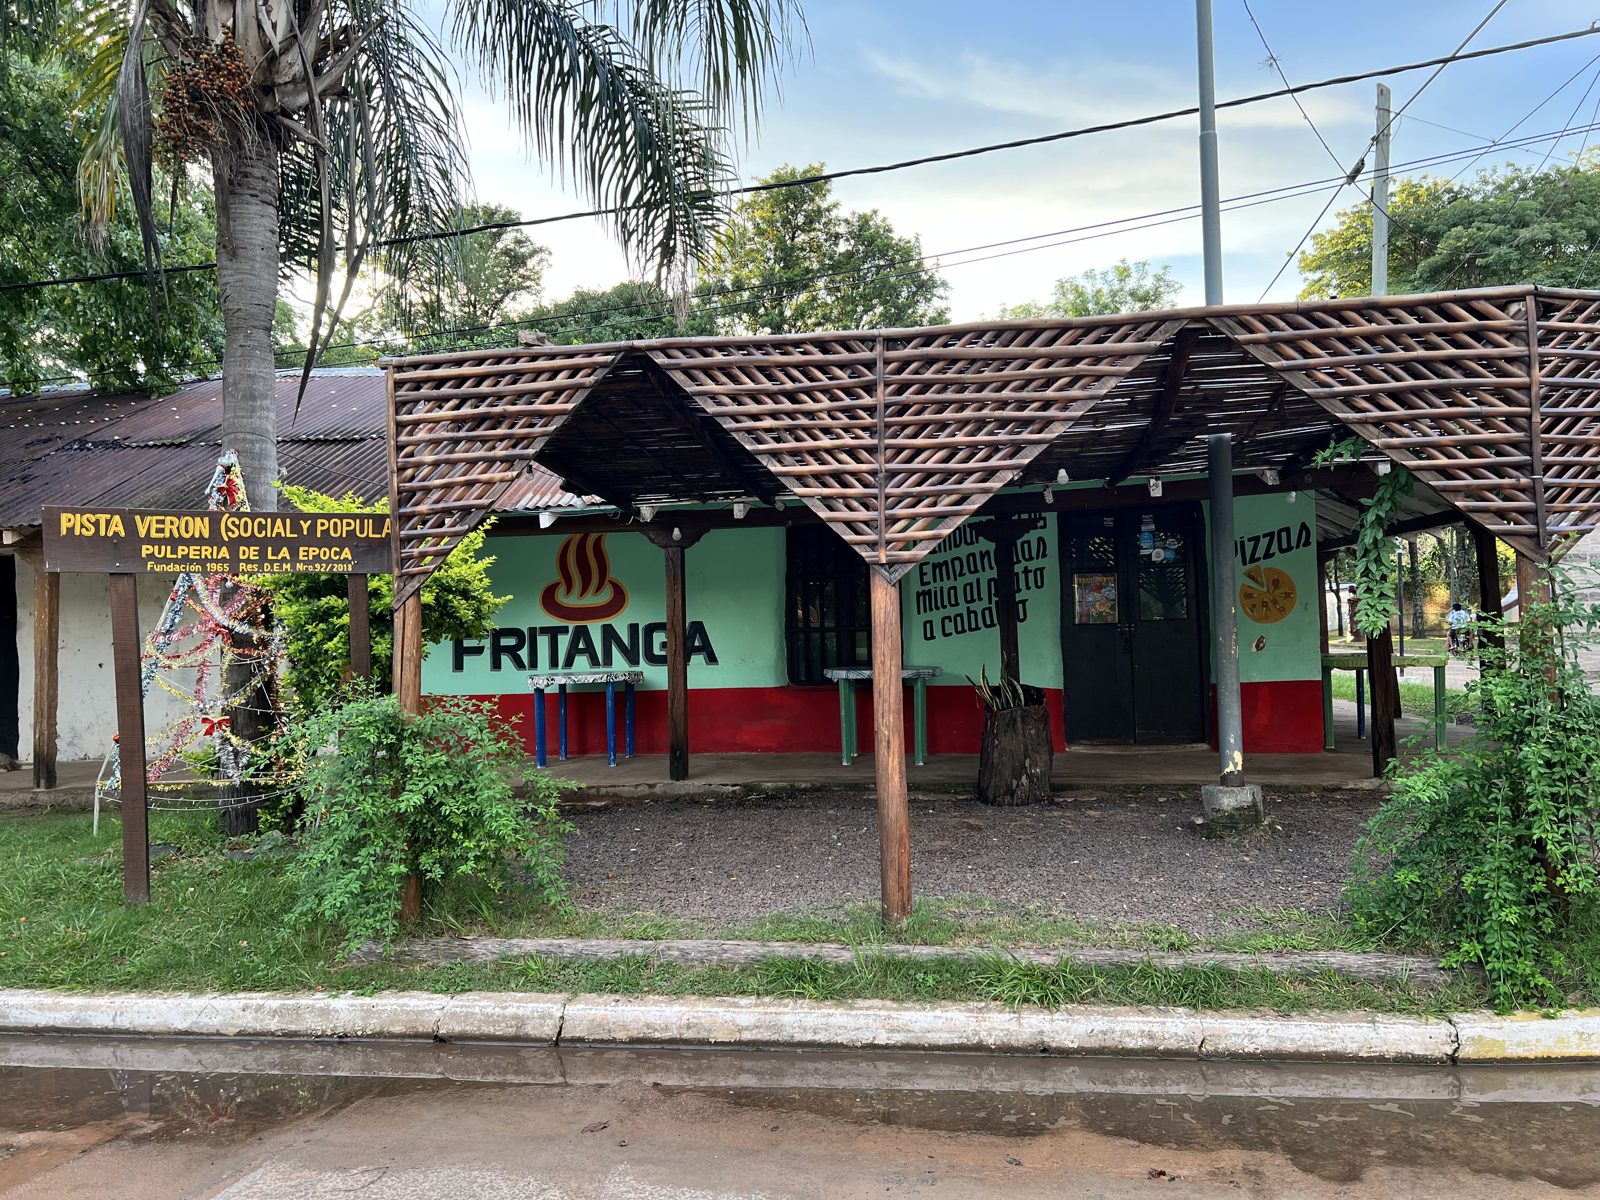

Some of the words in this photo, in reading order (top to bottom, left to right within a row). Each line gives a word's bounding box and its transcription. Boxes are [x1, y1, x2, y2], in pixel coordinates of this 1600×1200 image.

[60, 513, 126, 538] PISTA
[220, 513, 298, 542] (SOCIAL
[299, 520, 312, 536] Y
[316, 518, 392, 538] POPULA
[141, 545, 230, 559] PULPERIA
[239, 546, 259, 560] DE
[267, 547, 291, 560] LA
[299, 547, 352, 560] EPOCA
[147, 561, 202, 573] Fundación
[206, 562, 230, 572] 1965
[918, 536, 1048, 587] Empanas
[915, 585, 960, 615] mila
[962, 577, 984, 604] al
[986, 566, 1046, 606] pto
[922, 619, 937, 641] a
[940, 599, 1029, 638] cabao
[451, 620, 720, 673] FRITANGA
